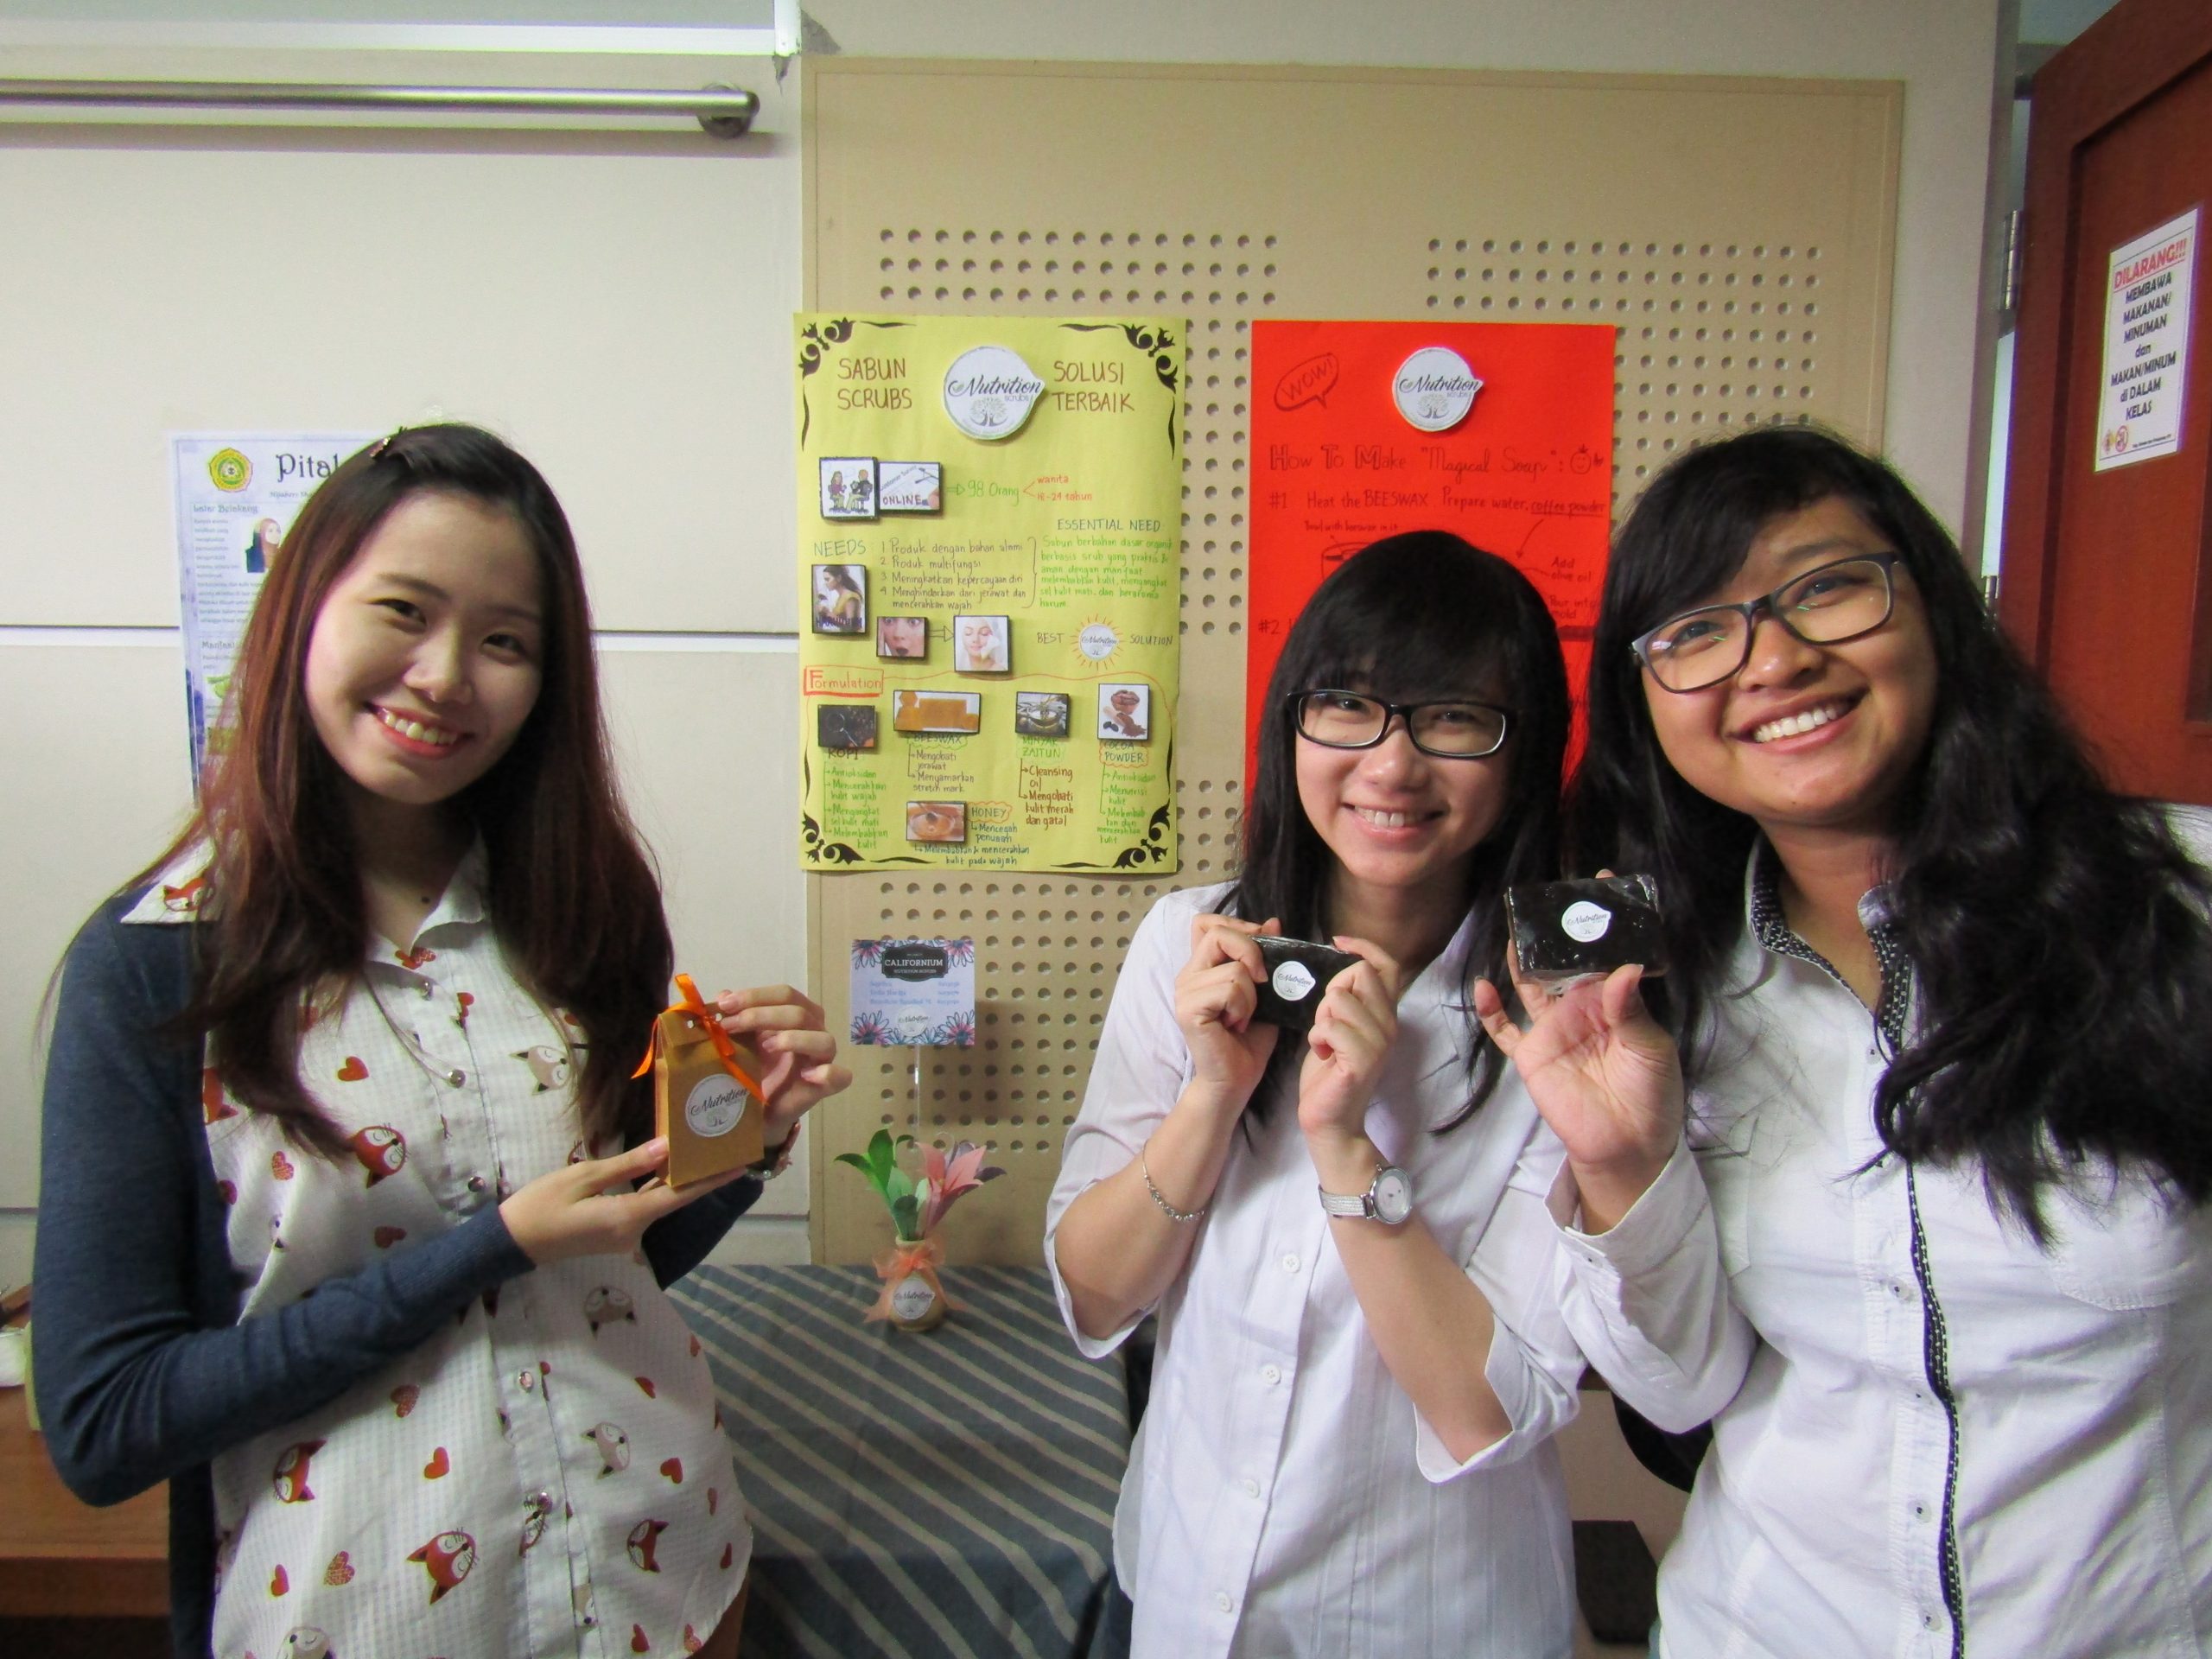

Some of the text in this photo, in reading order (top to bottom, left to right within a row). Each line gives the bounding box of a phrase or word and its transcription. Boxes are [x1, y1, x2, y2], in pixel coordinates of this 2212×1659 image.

[2113, 238, 2187, 289] DILARANG!!!
[2126, 271, 2172, 304] MEMBAWA
[2123, 291, 2172, 324] MAKANAN/
[2123, 314, 2167, 343] MINUMAN
[2135, 344, 2151, 358] dan
[837, 357, 1124, 385] SABUN SOLUSI
[2111, 352, 2176, 387] MAKAN/MINUM
[948, 374, 1041, 397] Nutrition
[1281, 358, 1334, 401] WOW!
[1399, 373, 1478, 392] Nutrition
[2129, 377, 2162, 398] DALAM
[837, 387, 1135, 413] SCRUBS TERBAIK
[2126, 400, 2152, 421] KELAS
[1270, 443, 1313, 470] How
[1320, 444, 1344, 469] To
[1354, 444, 1407, 470] Make
[1037, 474, 1070, 485] wanita
[883, 494, 922, 505] ONLINE
[967, 480, 1020, 506] 98 Orang
[1065, 491, 1092, 501] tahun
[1268, 492, 1288, 510] #1
[1306, 490, 1336, 509] Heat
[1341, 490, 1361, 508] the
[1442, 485, 1485, 512] Prepare
[1531, 499, 1566, 516] coffee
[1058, 518, 1160, 532] ESSENTIAL NEED
[814, 539, 867, 557] NEEDS
[891, 537, 925, 554] Produk
[932, 539, 966, 558] dengan
[969, 539, 995, 553] bahan
[1077, 535, 1116, 547] berbahan
[892, 556, 924, 569] Produk
[929, 557, 981, 576] multifungsi
[1108, 554, 1127, 567] yang
[1551, 556, 1576, 569] Add
[892, 572, 953, 588] Meningkatkan
[957, 574, 1007, 589] kepercayaan
[1009, 574, 1023, 584] diri
[1258, 619, 1281, 635] #2
[1037, 632, 1065, 644] BEST
[1129, 634, 1173, 646] SOLUTION
[810, 669, 882, 690] Formulation
[1022, 747, 1061, 758] ZAITUN
[1104, 752, 1144, 763] POWDER
[1029, 765, 1073, 783] Cleansing
[1029, 777, 1042, 791] Oil
[1028, 788, 1073, 805] Mengobati
[971, 806, 1007, 818] HONEY
[1047, 802, 1074, 814] merah
[1026, 815, 1067, 830] dan gatal
[1567, 912, 1608, 925] Nutrition
[884, 958, 944, 967] CALIFORNIUM
[1277, 973, 1313, 987] Nutrition
[690, 1087, 747, 1116] Nutrition
